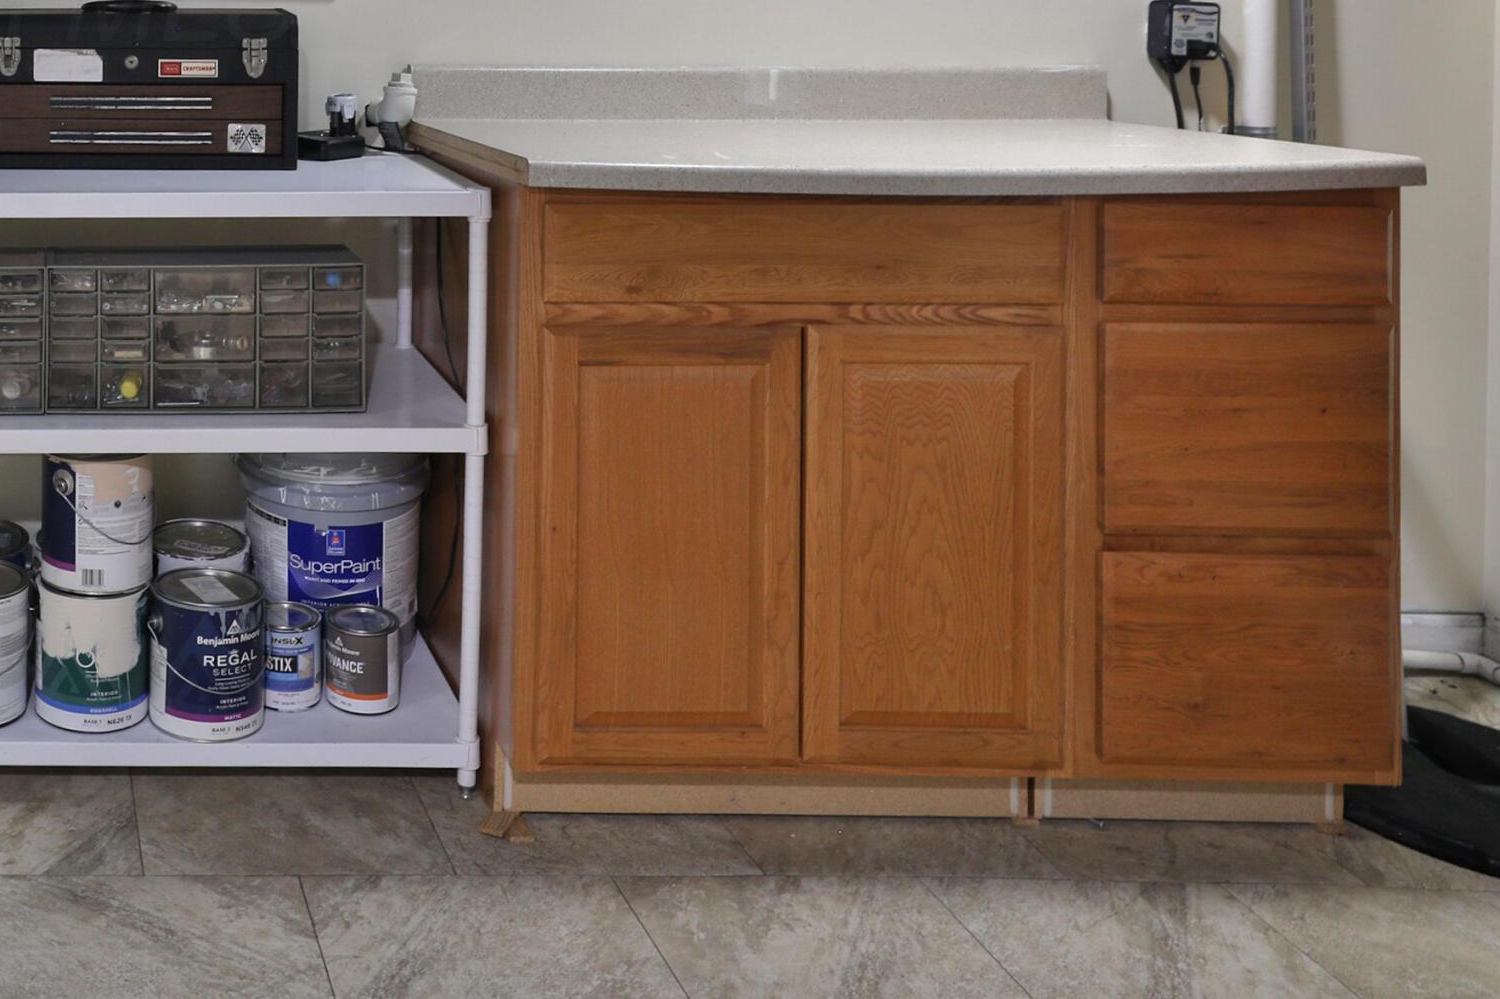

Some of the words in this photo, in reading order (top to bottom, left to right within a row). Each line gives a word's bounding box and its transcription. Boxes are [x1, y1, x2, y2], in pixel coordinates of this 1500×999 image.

[290, 553, 381, 575] SuperPaint
[196, 635, 239, 648] Benjamin
[203, 648, 257, 667] REGAL
[266, 656, 292, 672] STIX
[212, 663, 252, 676] SELECT
